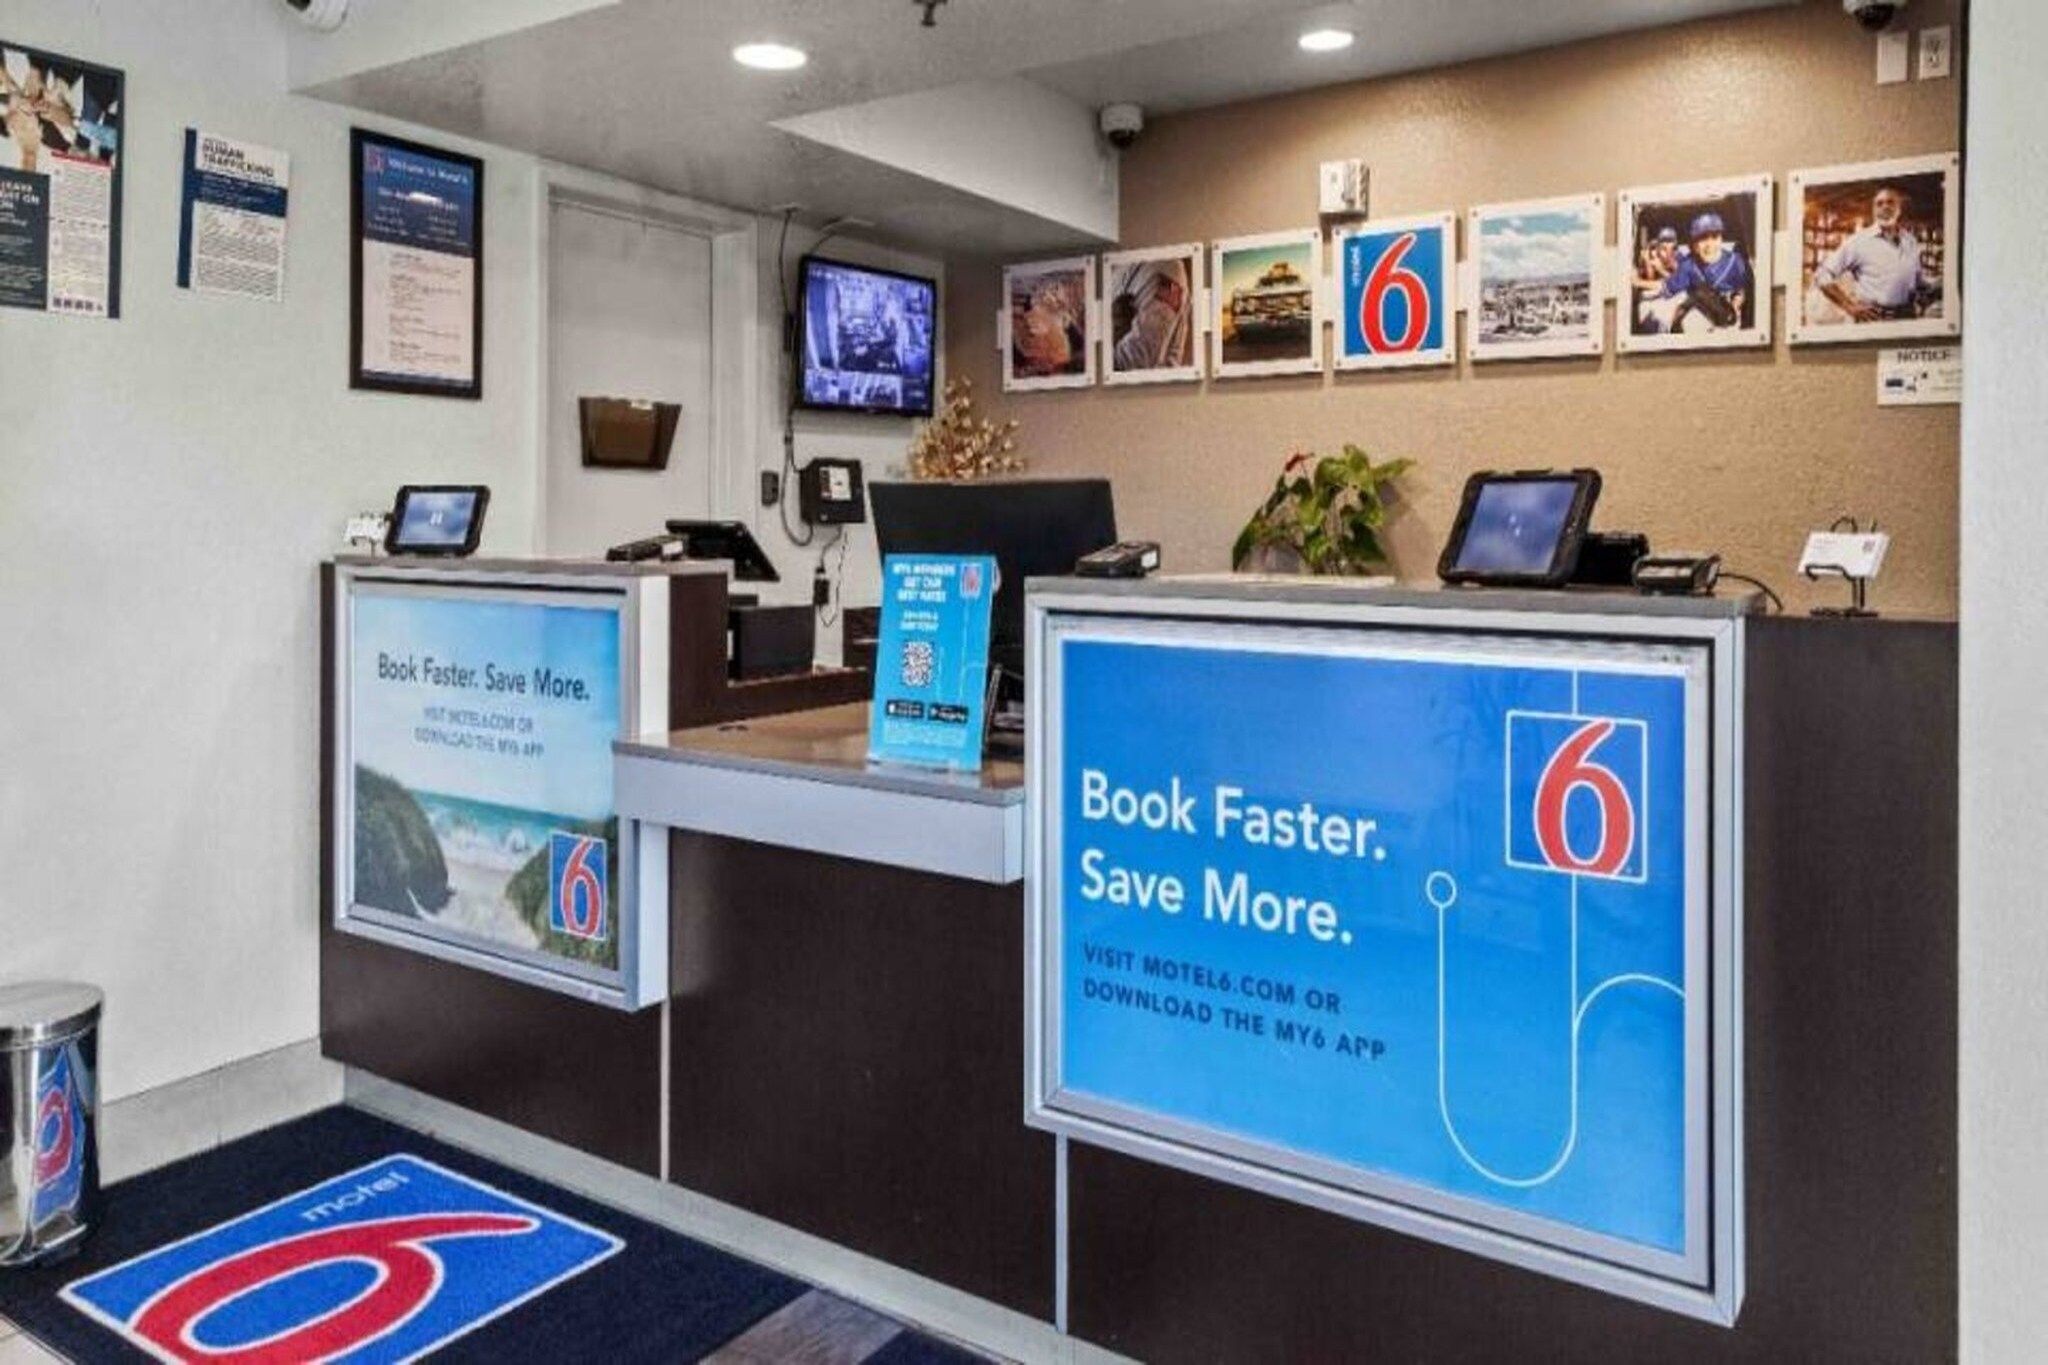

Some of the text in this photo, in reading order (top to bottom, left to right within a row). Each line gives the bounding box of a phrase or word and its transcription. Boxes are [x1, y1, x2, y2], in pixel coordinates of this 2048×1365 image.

[203, 153, 274, 177] TRAFFICKING
[1359, 232, 1431, 356] 6
[378, 652, 591, 701] Book Faster. Save More.
[1081, 768, 1386, 861] Book Faster.
[1533, 717, 1635, 877] 6
[560, 834, 602, 939] 6
[1080, 848, 1353, 945] Save More.
[1083, 941, 1342, 1014] VISIT MOTEL6.COM OR
[1083, 976, 1387, 1061] DOWNLOAD THE MY6 APP
[301, 1170, 410, 1222] motel
[129, 1211, 541, 1365] 6
